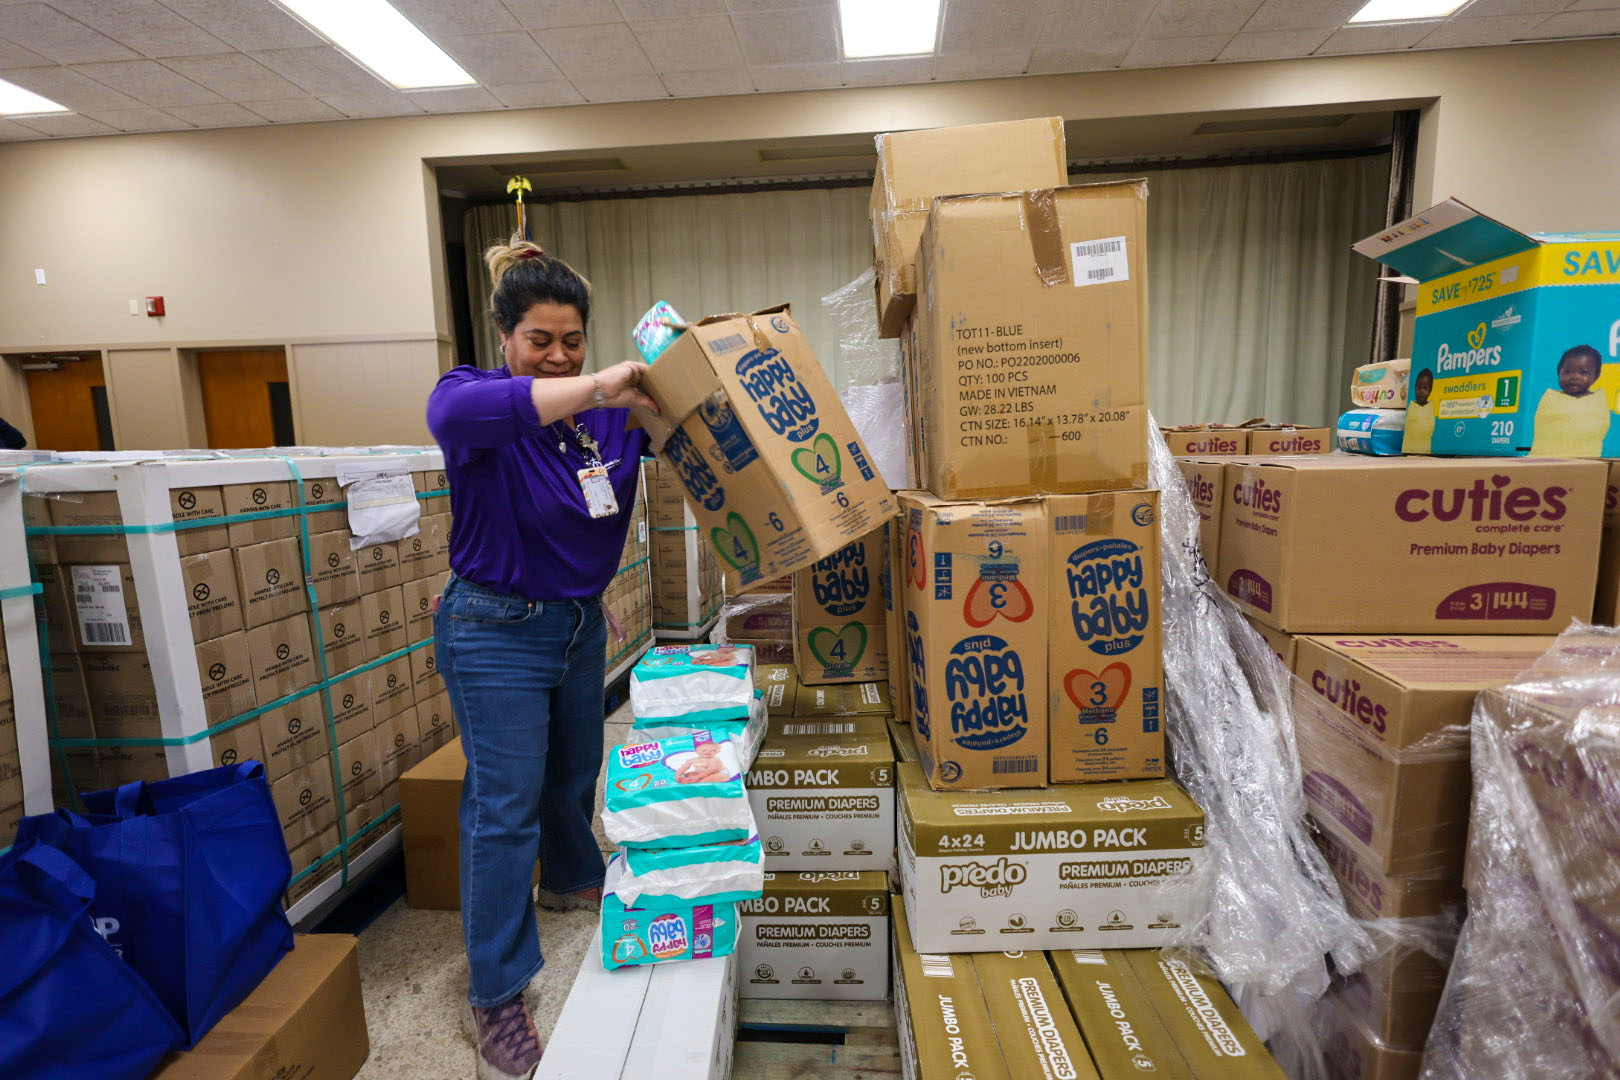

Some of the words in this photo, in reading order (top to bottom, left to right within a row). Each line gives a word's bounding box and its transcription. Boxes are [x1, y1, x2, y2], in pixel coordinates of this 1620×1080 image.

[1562, 249, 1620, 276] SAV
[1432, 282, 1460, 304] SAVE
[958, 344, 984, 357] (new
[986, 340, 1027, 353] bottom
[1029, 338, 1063, 350] insert)
[958, 359, 974, 371] PO
[976, 358, 998, 370] NO.:
[1001, 354, 1080, 368] PO2202000006
[1437, 342, 1502, 373] Pampers
[740, 356, 794, 402] happy
[958, 375, 984, 387] QTY:
[986, 373, 1005, 384] 100
[1008, 371, 1028, 382] PCS
[1444, 381, 1486, 394] swaddlers
[1503, 379, 1510, 397] 1
[960, 390, 992, 402] MADE
[994, 388, 1005, 398] IN
[1008, 385, 1056, 398] VIETNAM
[758, 381, 816, 436] baby
[960, 406, 982, 416] GW:
[984, 403, 1012, 415] 28.22
[1015, 402, 1034, 412] LBS
[796, 424, 814, 439] plus
[960, 420, 982, 432] CTN
[985, 418, 1010, 430] SIZE:
[1047, 418, 1054, 426] x
[1491, 420, 1514, 436] 210
[960, 435, 982, 447] CTN
[985, 434, 1008, 446] NO.:
[1186, 437, 1237, 453] cuties
[1269, 435, 1322, 452] cuties
[815, 454, 830, 475] 4
[1188, 473, 1214, 503] uties
[1233, 479, 1282, 513] cuties
[837, 492, 849, 507] 6
[1395, 474, 1568, 521] cuties
[768, 512, 784, 531] 6
[1476, 524, 1530, 534] complete
[1534, 524, 1561, 532] care
[732, 534, 748, 560] 4
[1410, 542, 1468, 556] Premium
[1471, 543, 1506, 557] Baby
[1508, 543, 1560, 557] Diapers
[812, 566, 870, 605] baby
[1067, 556, 1143, 599] happy
[990, 584, 1008, 608] 3
[1470, 593, 1484, 610] 3
[1493, 592, 1528, 609] 144
[1072, 588, 1149, 641] baby
[829, 638, 848, 660] 4
[964, 640, 991, 652] plus
[1105, 639, 1131, 653] plus
[1334, 637, 1460, 650] cuties
[945, 651, 1024, 702] baby
[1089, 682, 1108, 705] 3
[1311, 669, 1389, 734] cuties
[951, 693, 1028, 734] happy
[1094, 728, 1108, 746] 6
[620, 742, 659, 757] happy
[622, 750, 662, 767] baby
[746, 769, 788, 786] MBO
[794, 769, 840, 785] PACK
[879, 770, 888, 781] 5
[769, 798, 825, 810] PREMIUM
[829, 797, 877, 809] DIAPERS
[938, 833, 986, 849] 4x24
[1010, 830, 1087, 850] JUMBO
[1093, 827, 1147, 847] PACK
[1193, 827, 1203, 841] 5
[940, 857, 1027, 893] predo
[1061, 863, 1129, 878] PREMIUM
[980, 884, 1013, 898] baby
[1059, 880, 1089, 889] PAÑALES
[1090, 881, 1122, 889] PREMIUM
[739, 897, 779, 912] MBO
[785, 897, 830, 913] PACK
[871, 898, 880, 909] 5
[649, 918, 685, 943] baby
[758, 926, 816, 937] PREMIUM
[819, 926, 868, 937] DIAPERS
[652, 938, 687, 953] happy
[938, 994, 961, 1035] JUMBO
[1096, 981, 1125, 1019] JUMBO
[1115, 1019, 1143, 1052] PACK
[1169, 960, 1209, 1010] PREMIUM
[1202, 1005, 1244, 1055] DIAPERS
[1021, 978, 1053, 1029] PREMIUM
[1043, 1025, 1075, 1079] DIAPERS
[948, 1036, 969, 1069] PACK
